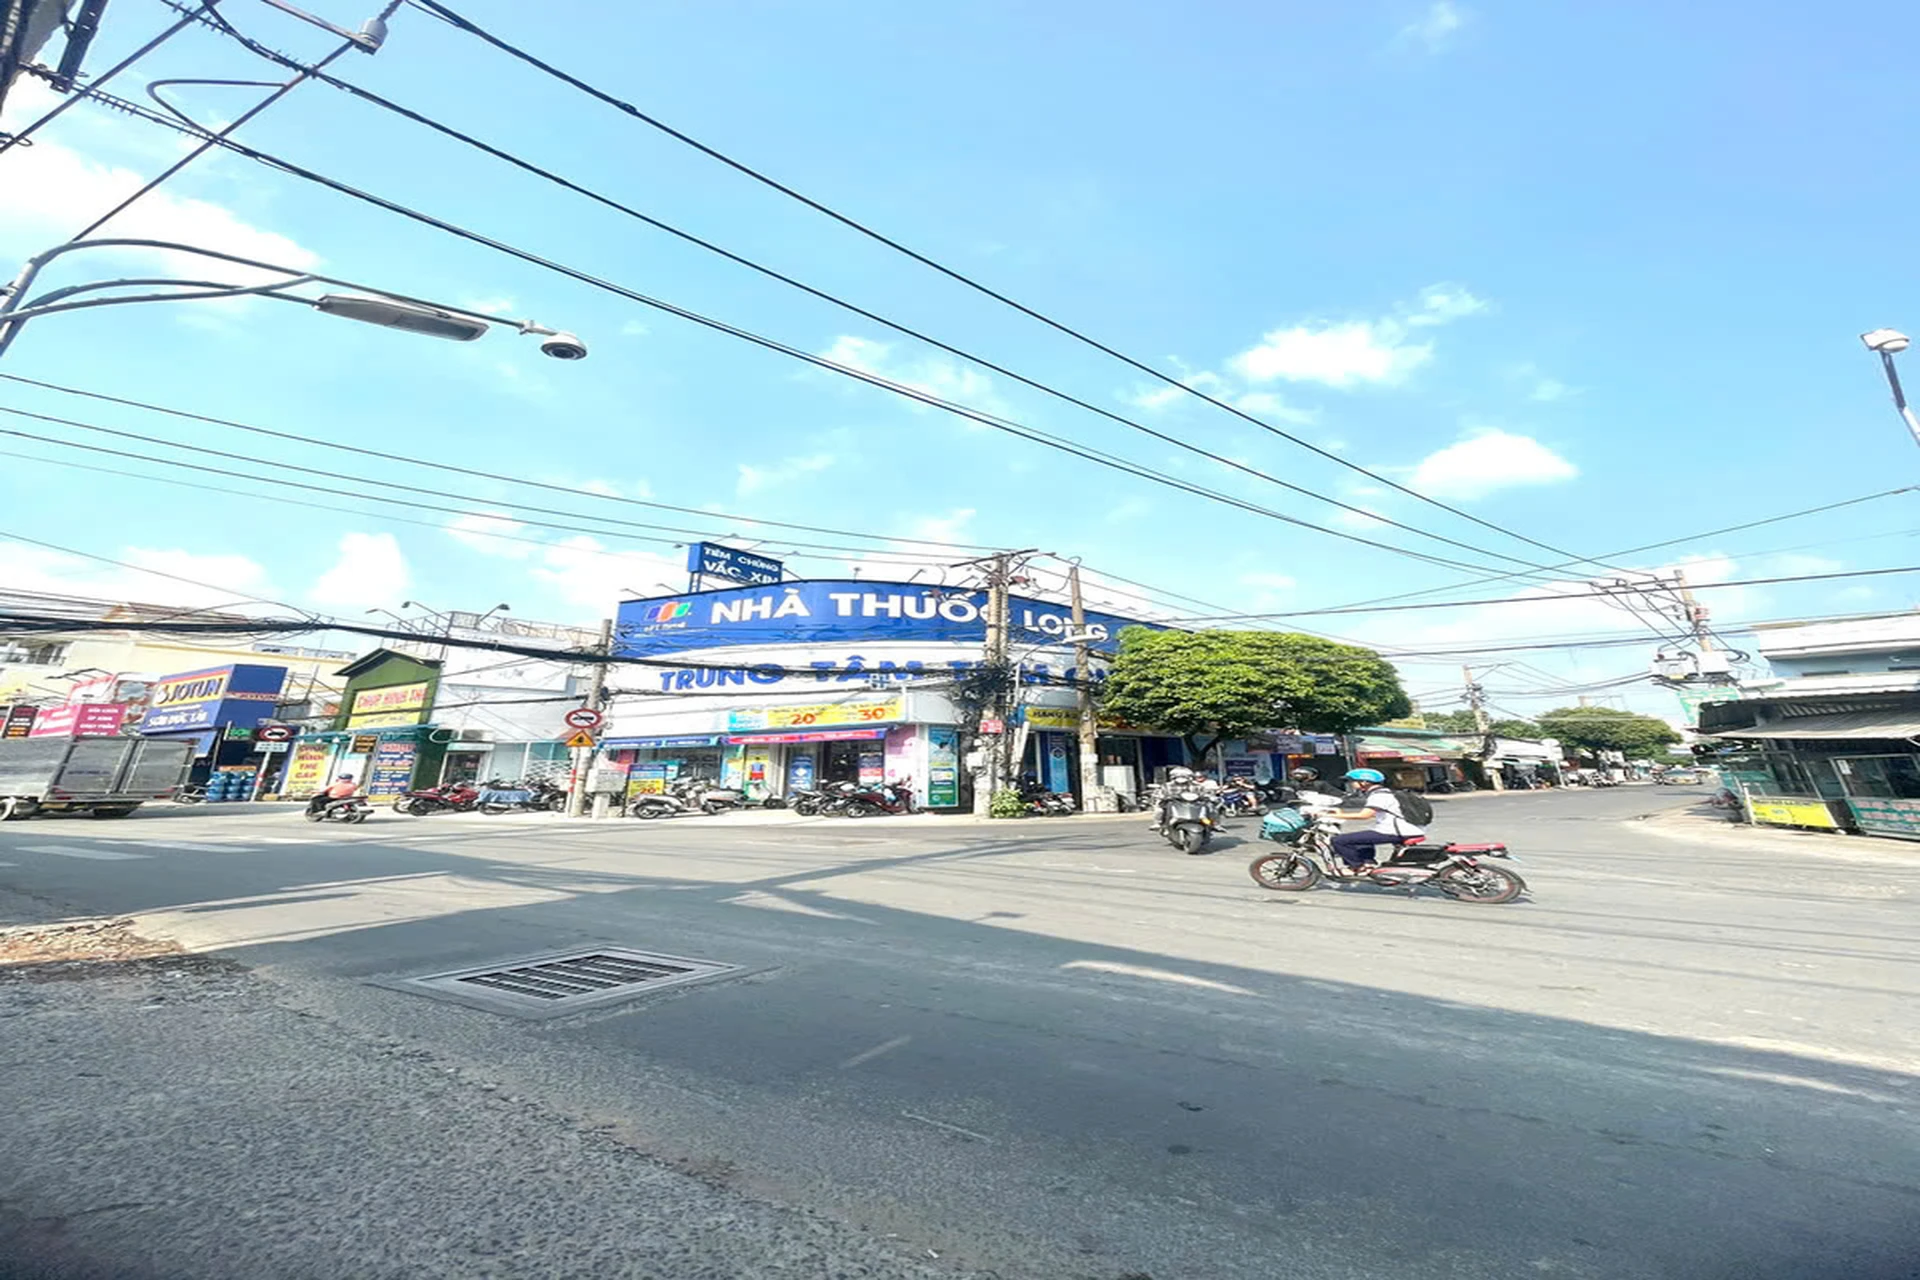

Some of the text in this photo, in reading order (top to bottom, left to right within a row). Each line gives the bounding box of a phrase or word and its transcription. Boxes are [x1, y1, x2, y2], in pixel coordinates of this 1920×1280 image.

[704, 546, 731, 561] TIÊM
[704, 559, 742, 579] VẮC
[710, 587, 812, 625] NHÀ
[168, 677, 226, 705] JOTUN
[659, 662, 786, 692] TRUNG
